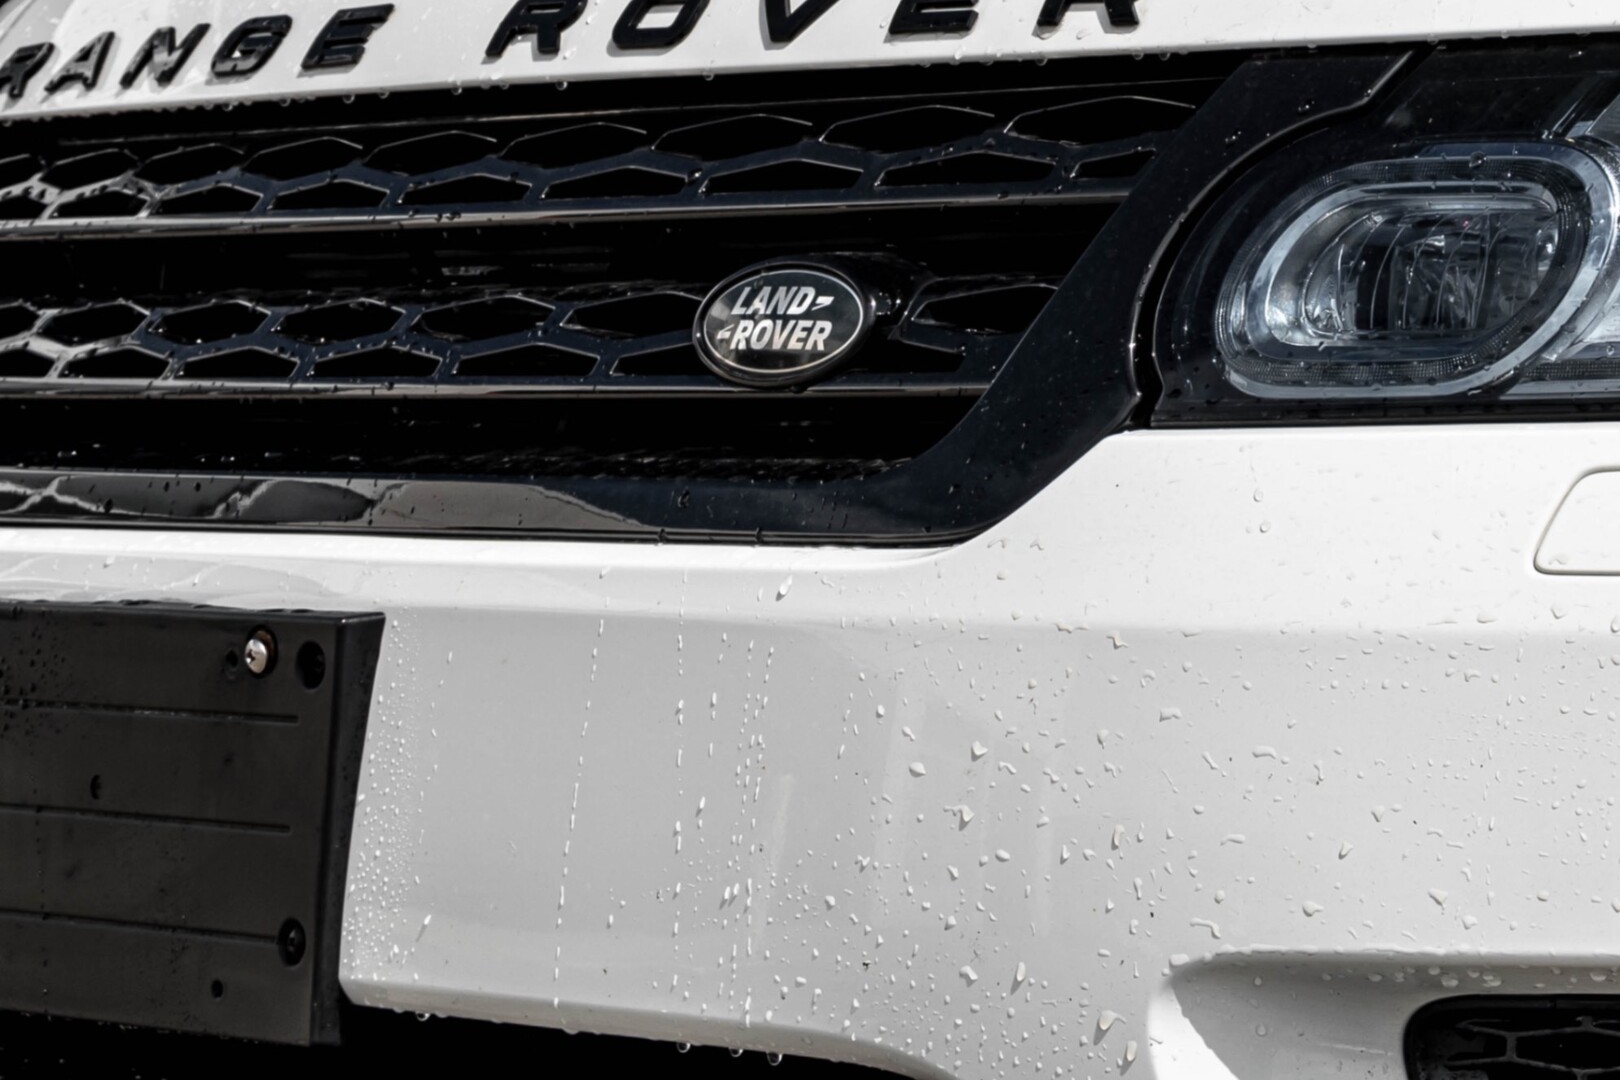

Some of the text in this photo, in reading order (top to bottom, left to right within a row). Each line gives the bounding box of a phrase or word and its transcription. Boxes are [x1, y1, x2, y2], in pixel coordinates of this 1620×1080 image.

[0, 3, 395, 98] RANGE
[731, 286, 816, 315] LAND
[729, 319, 833, 350] ROVER
